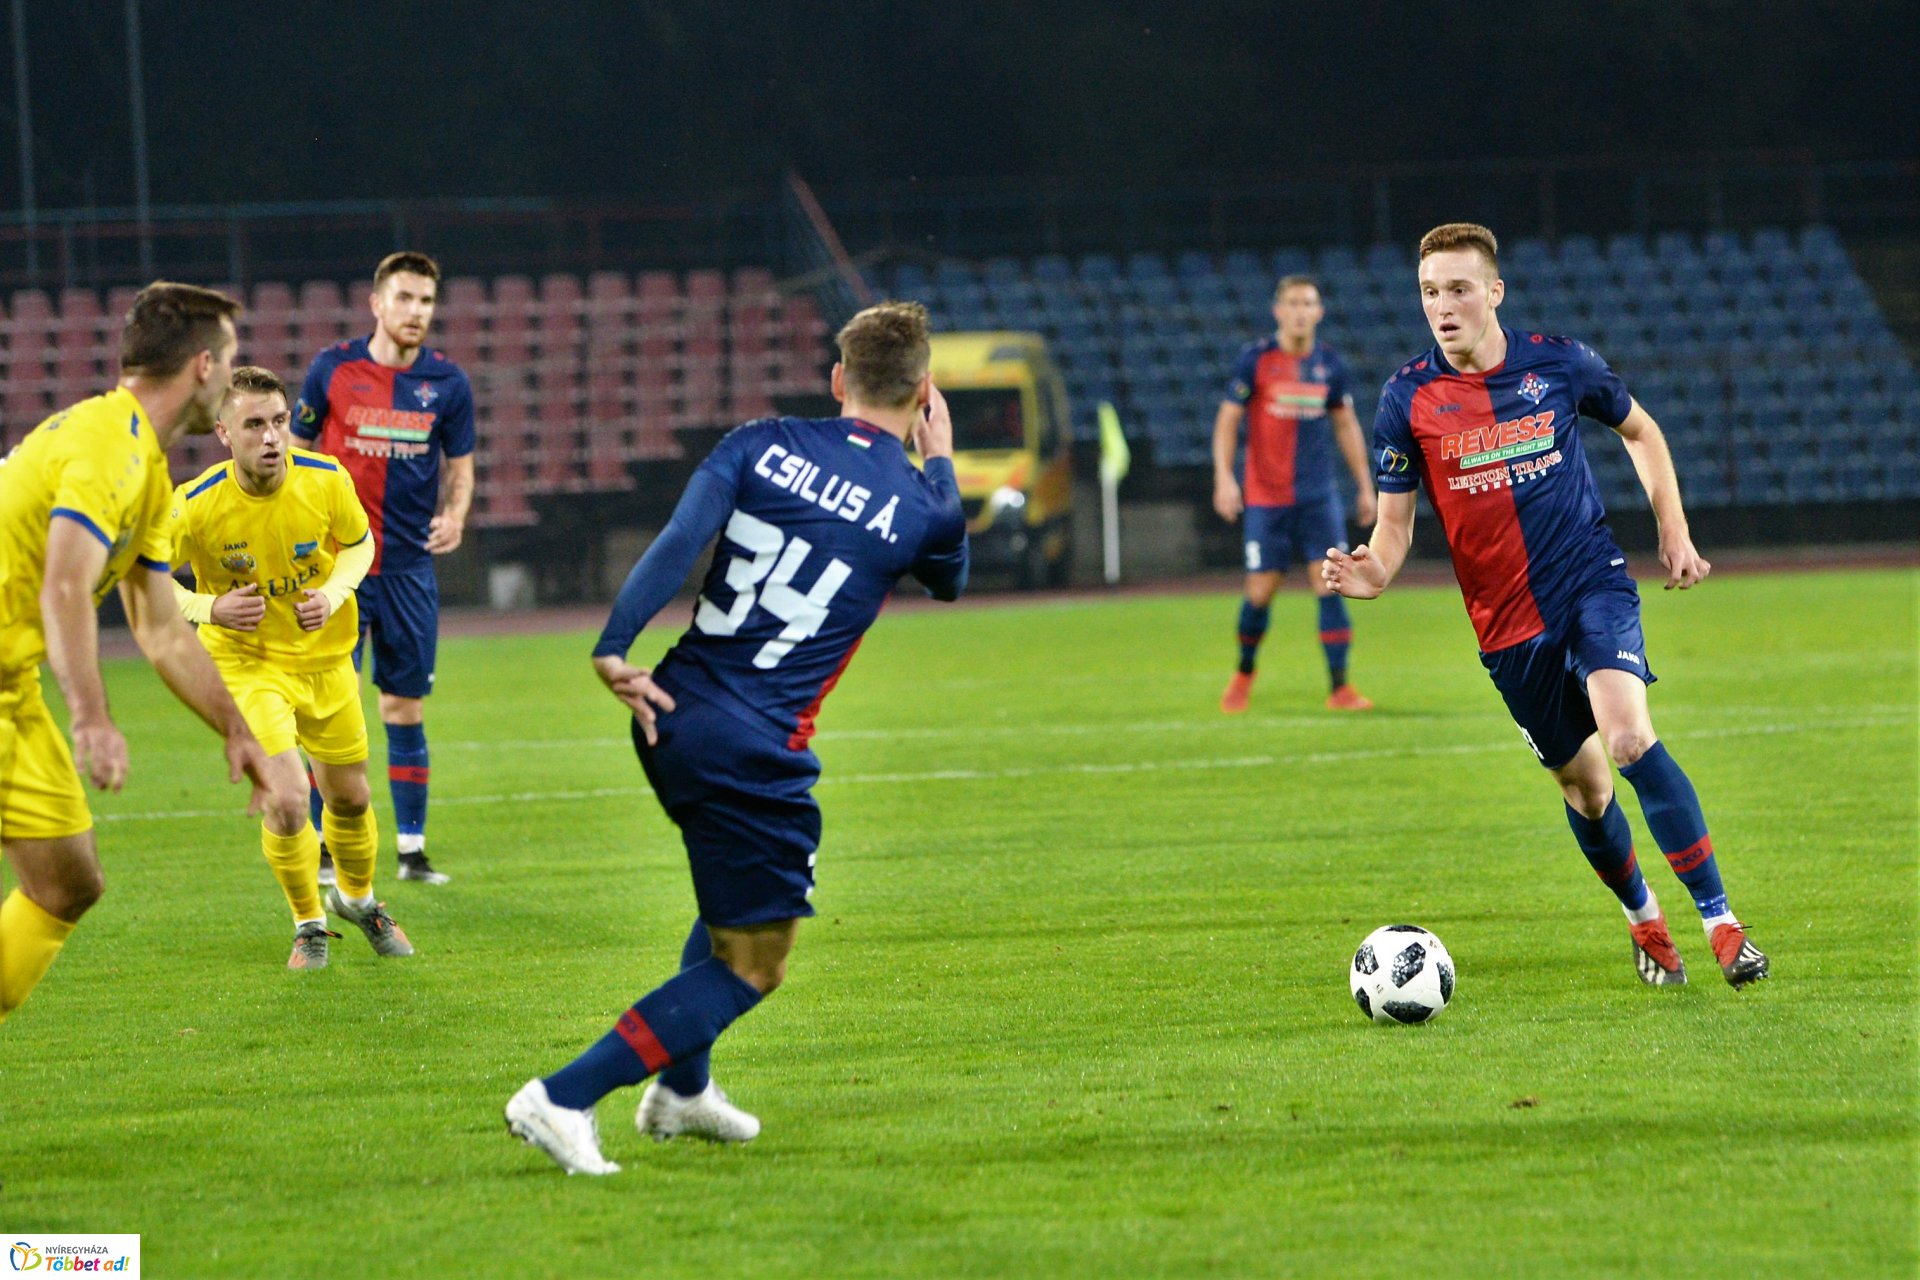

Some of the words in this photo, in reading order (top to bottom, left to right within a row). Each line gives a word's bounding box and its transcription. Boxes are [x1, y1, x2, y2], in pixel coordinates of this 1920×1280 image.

[1441, 410, 1555, 460] REVESZ
[1463, 454, 1490, 466] ALWAYS
[1490, 451, 1501, 460] ON
[1502, 448, 1515, 457] THE
[1517, 443, 1537, 453] RIGHT
[1538, 438, 1553, 448] WAY
[753, 443, 872, 523] CSILUS
[1448, 466, 1512, 490] LERTON
[1511, 450, 1563, 476] TRANS
[223, 541, 248, 552] JAKO
[695, 508, 853, 670] 34
[1616, 649, 1640, 665] JAKO
